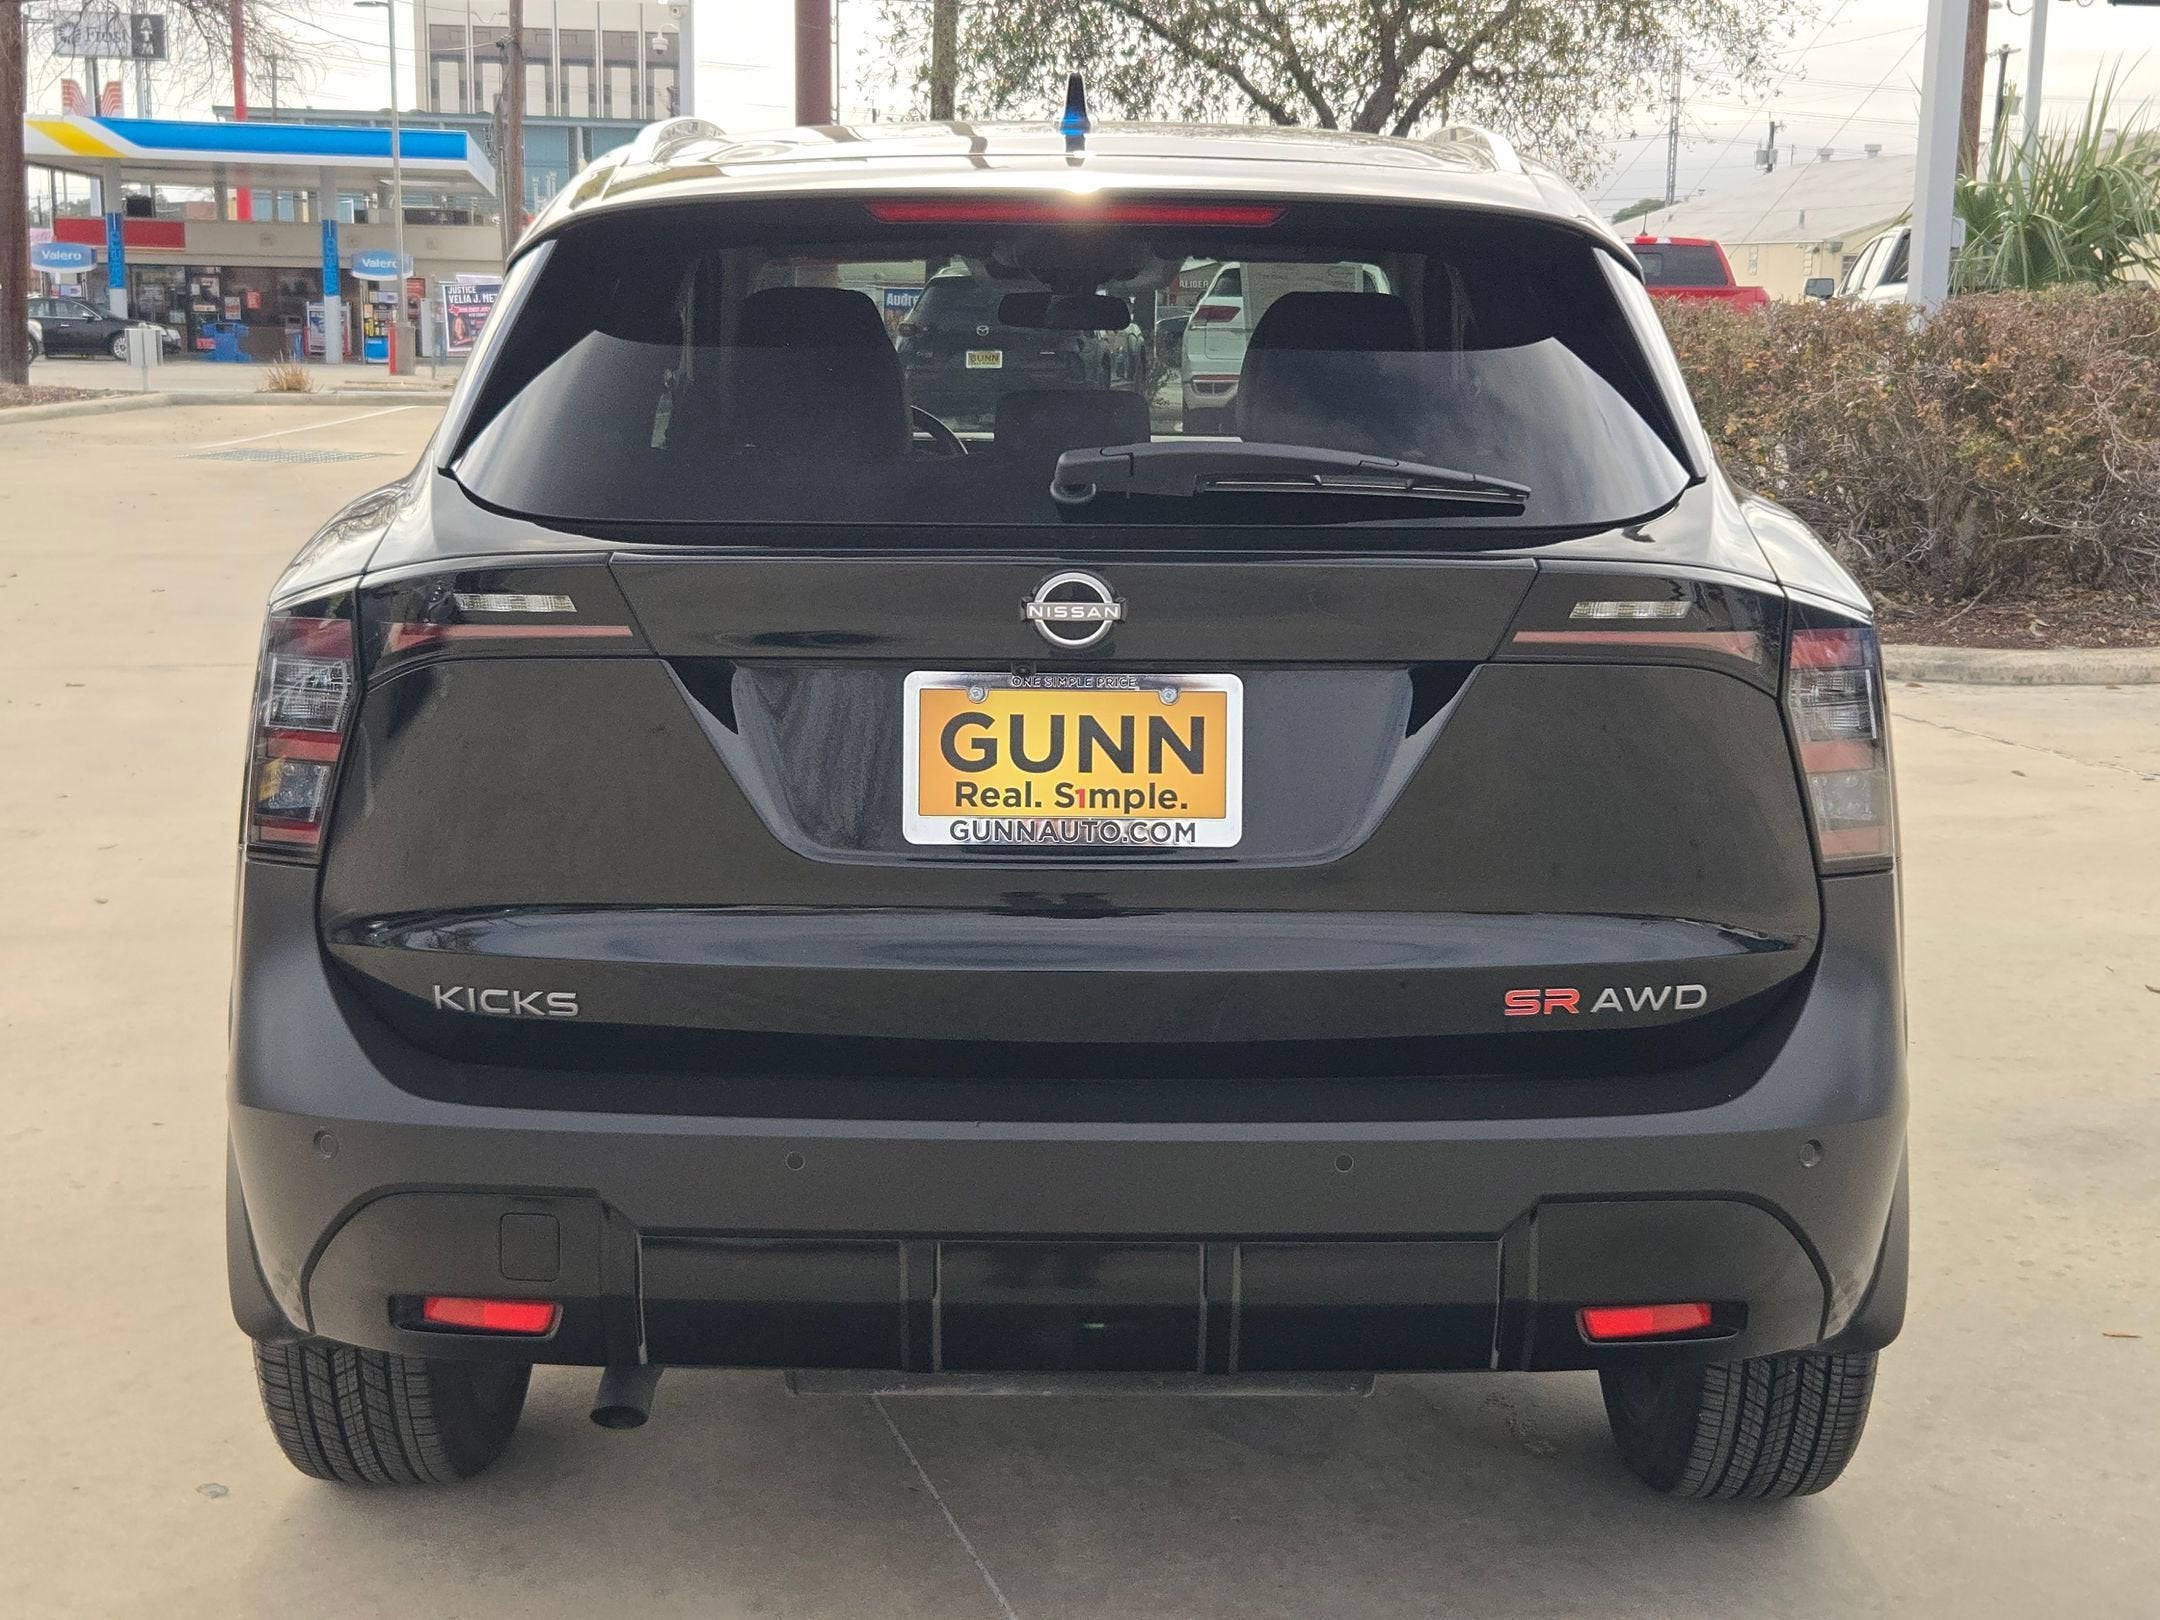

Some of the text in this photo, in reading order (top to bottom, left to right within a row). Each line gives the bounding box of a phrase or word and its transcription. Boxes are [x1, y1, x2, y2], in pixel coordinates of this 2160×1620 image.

[140, 17, 154, 55] ATM
[42, 249, 82, 261] Valero
[447, 286, 477, 294] JUSTICE
[448, 293, 472, 304] VELIA
[969, 353, 999, 363] GUNN
[1028, 605, 1119, 618] NISSAN
[1012, 675, 1138, 689] ONE SIMPLE PRICE
[940, 711, 1205, 775] GUNN
[955, 781, 1188, 814] Real. S1mple.
[949, 819, 1196, 844] GUNNAUTO.COM
[433, 985, 579, 1017] KICKS
[1504, 984, 1708, 1016] SR AWD
